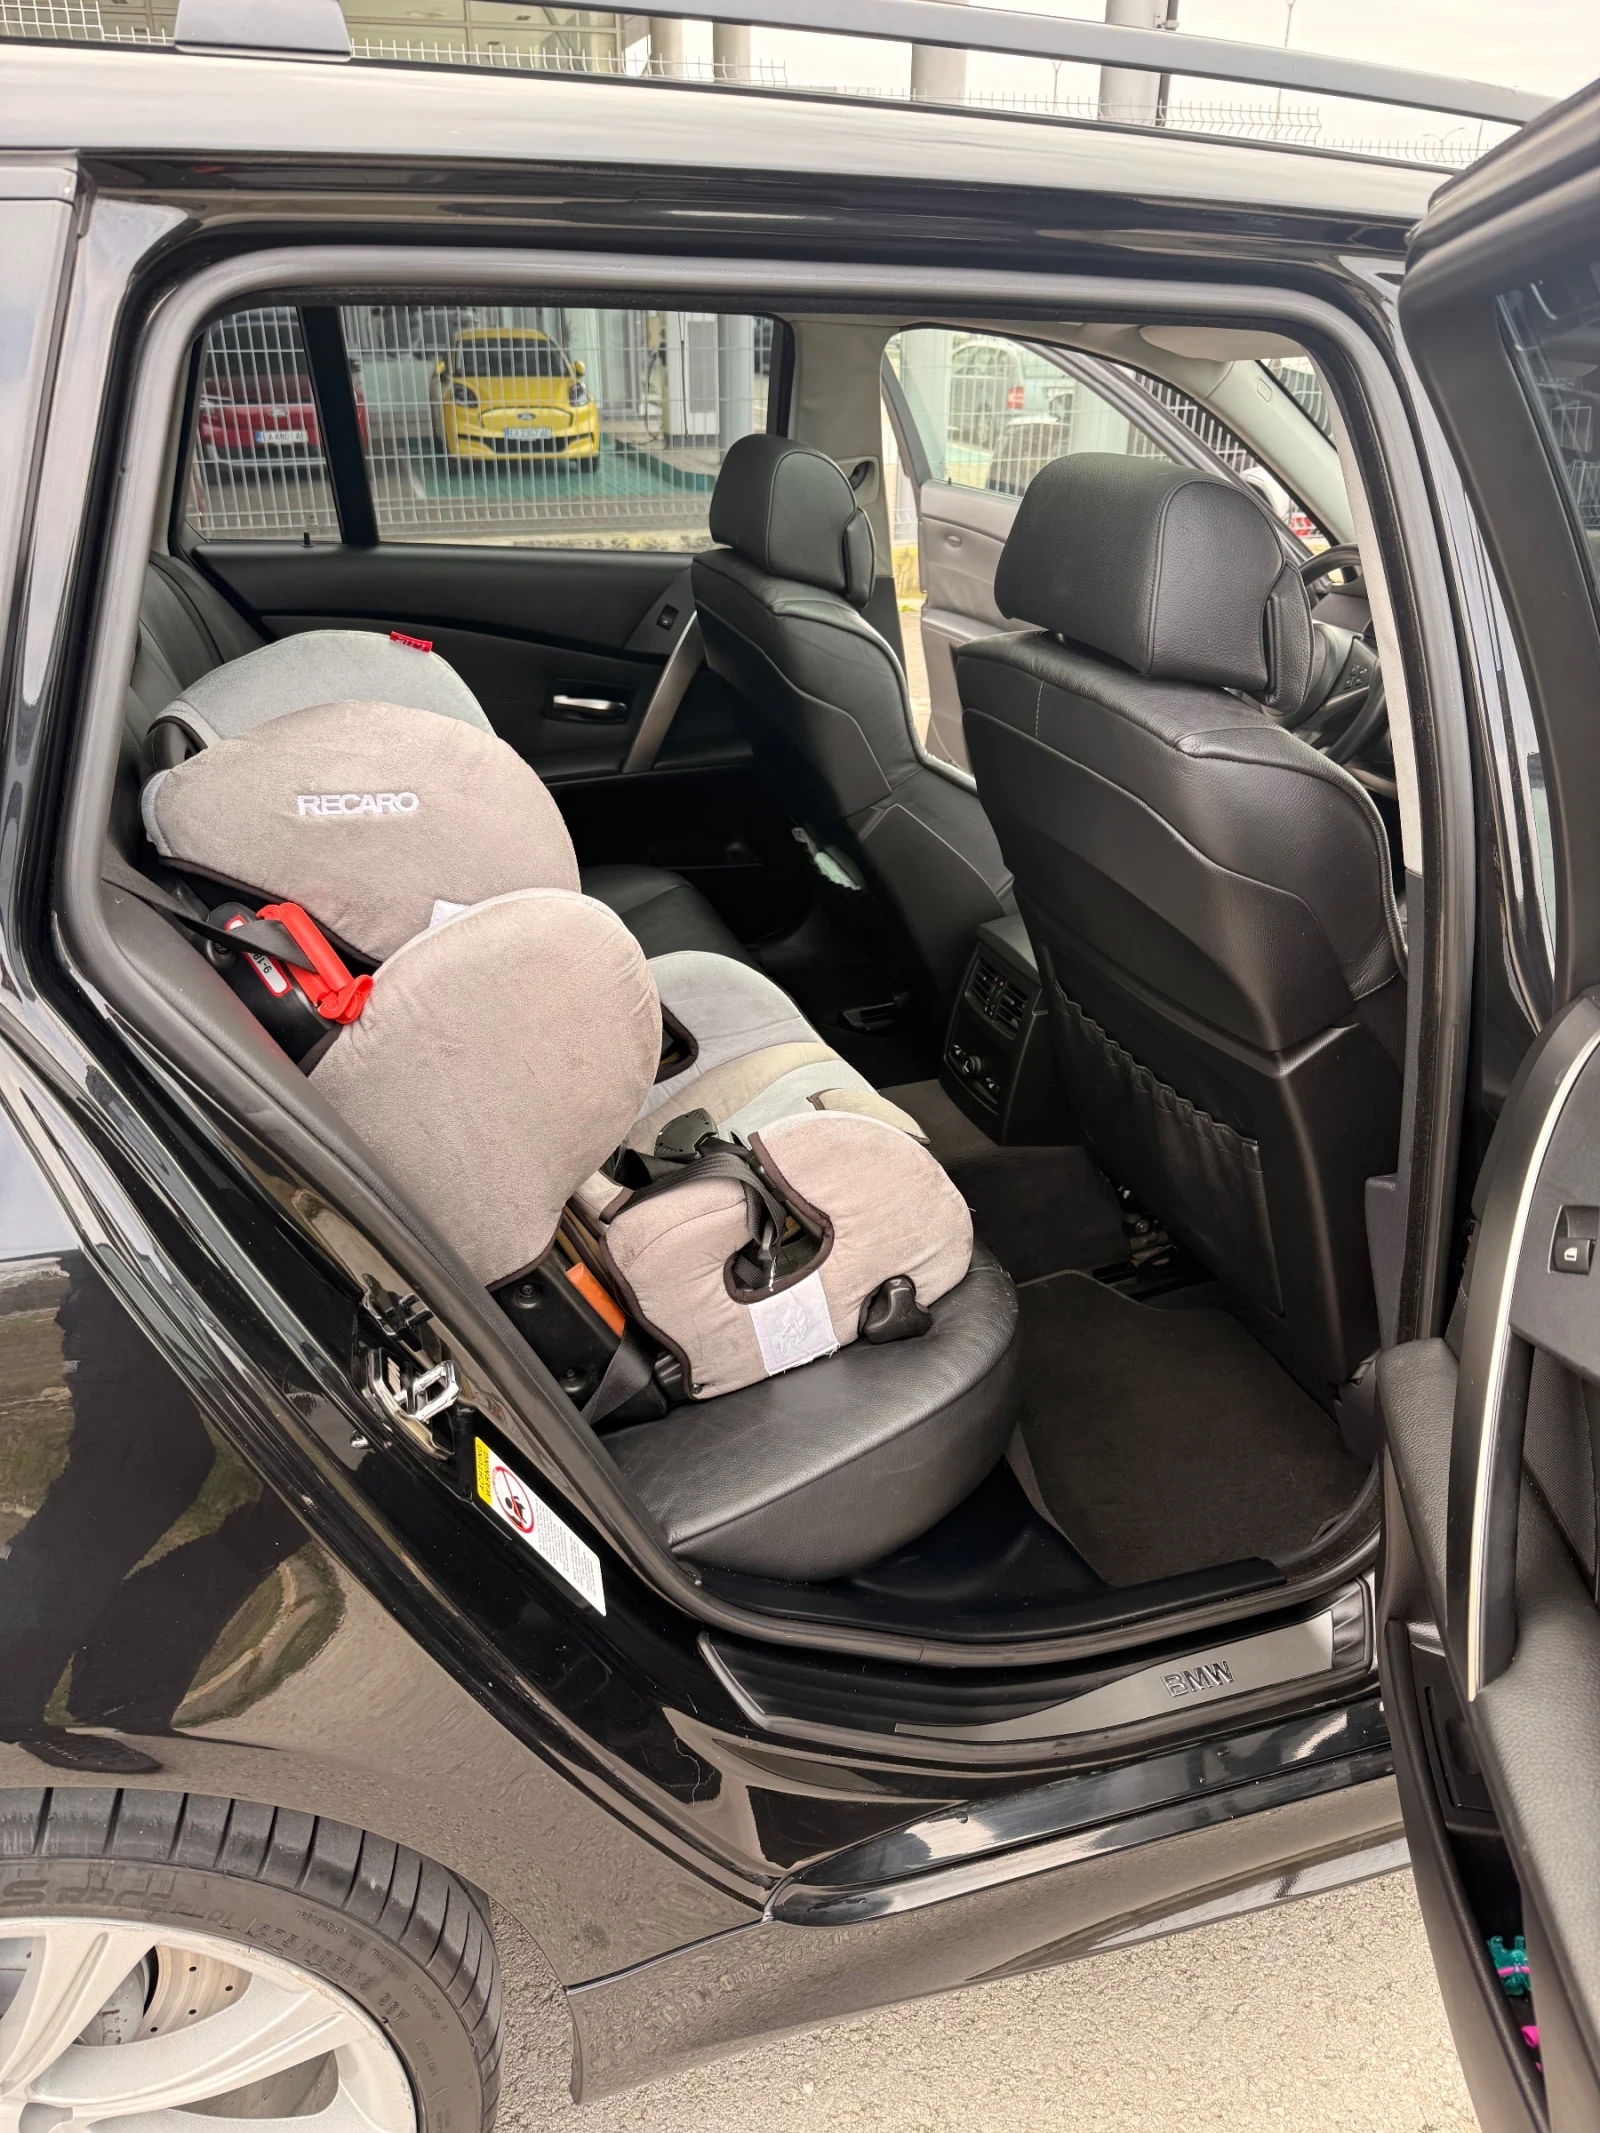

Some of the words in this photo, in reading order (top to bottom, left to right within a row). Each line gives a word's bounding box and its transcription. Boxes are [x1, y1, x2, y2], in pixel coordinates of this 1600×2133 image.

[297, 792, 420, 815] RECARO
[477, 1444, 485, 1492] ACHTUNG
[483, 1451, 491, 1497] WARNING
[1160, 1660, 1235, 1697] BMW
